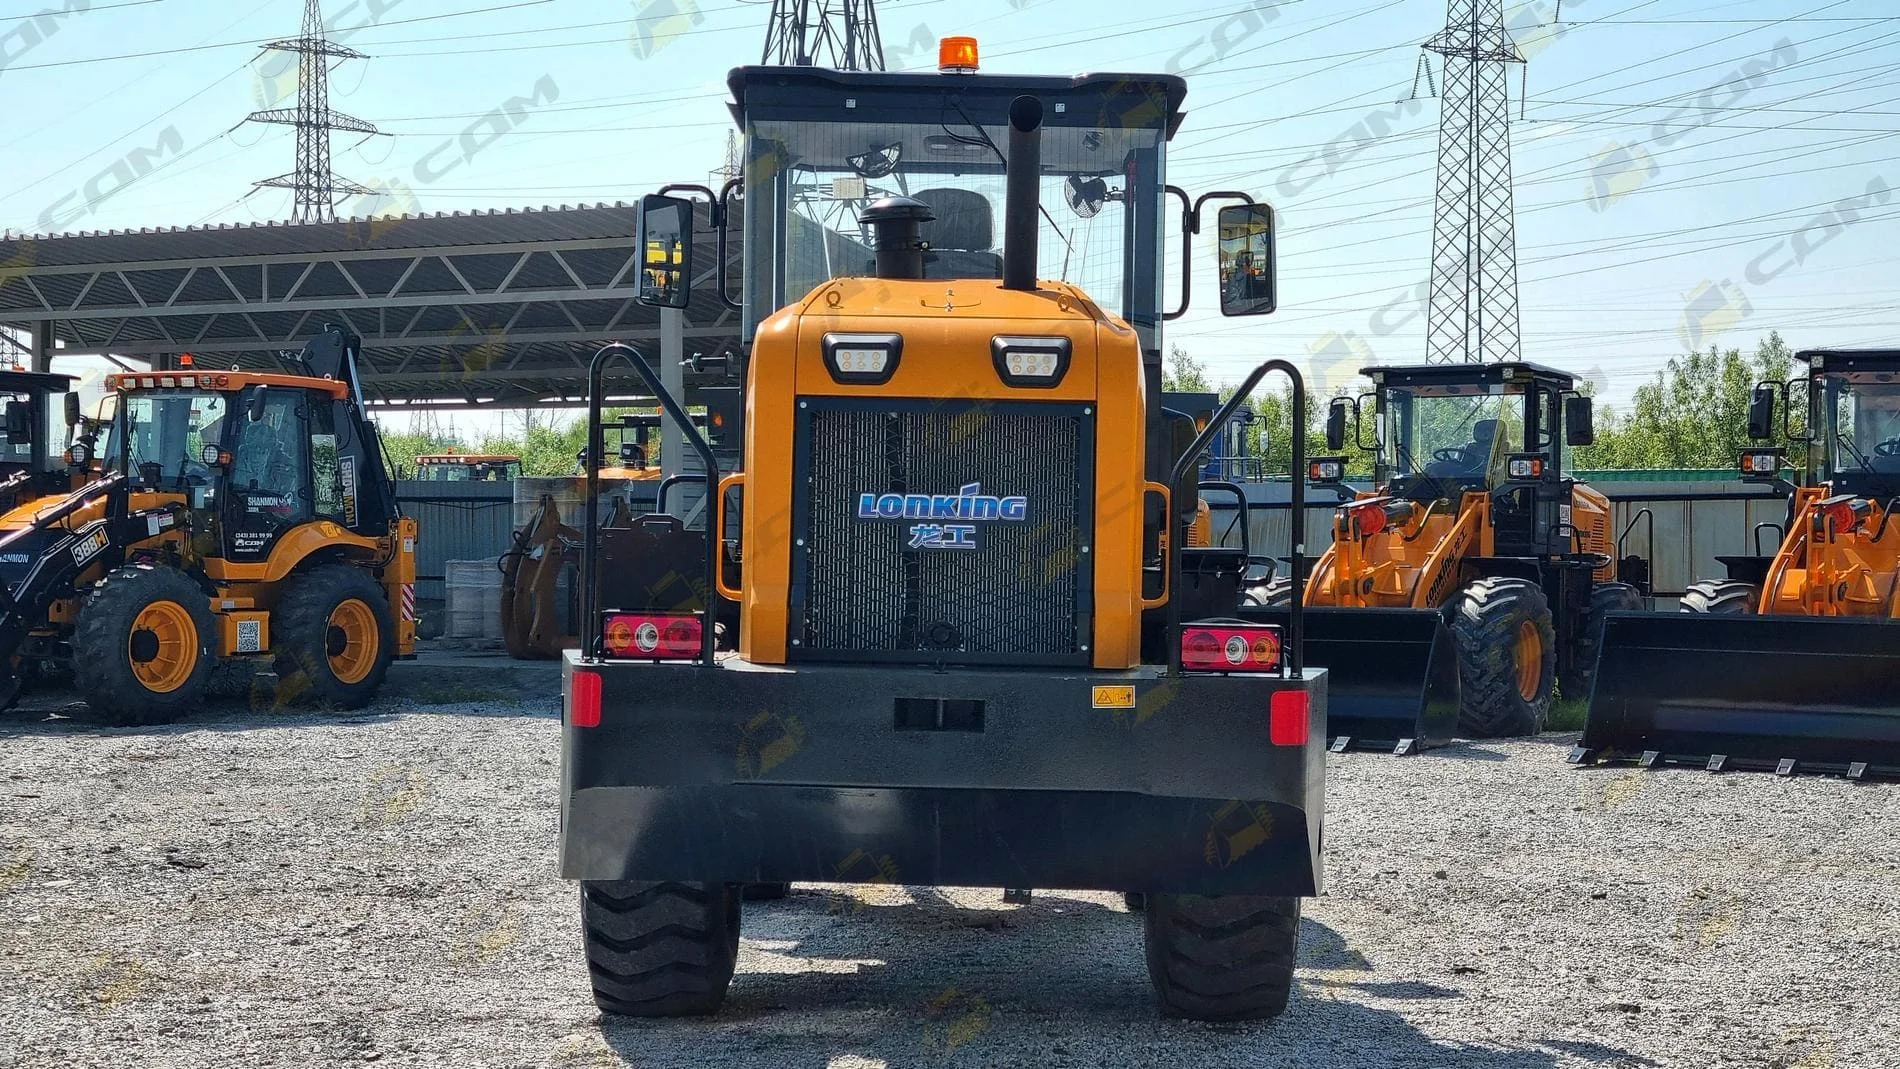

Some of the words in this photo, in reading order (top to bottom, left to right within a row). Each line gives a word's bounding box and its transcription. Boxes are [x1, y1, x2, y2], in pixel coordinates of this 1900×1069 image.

[247, 496, 278, 506] SHANMON
[341, 461, 355, 523] SHANMON
[908, 524, 977, 549] 龙工
